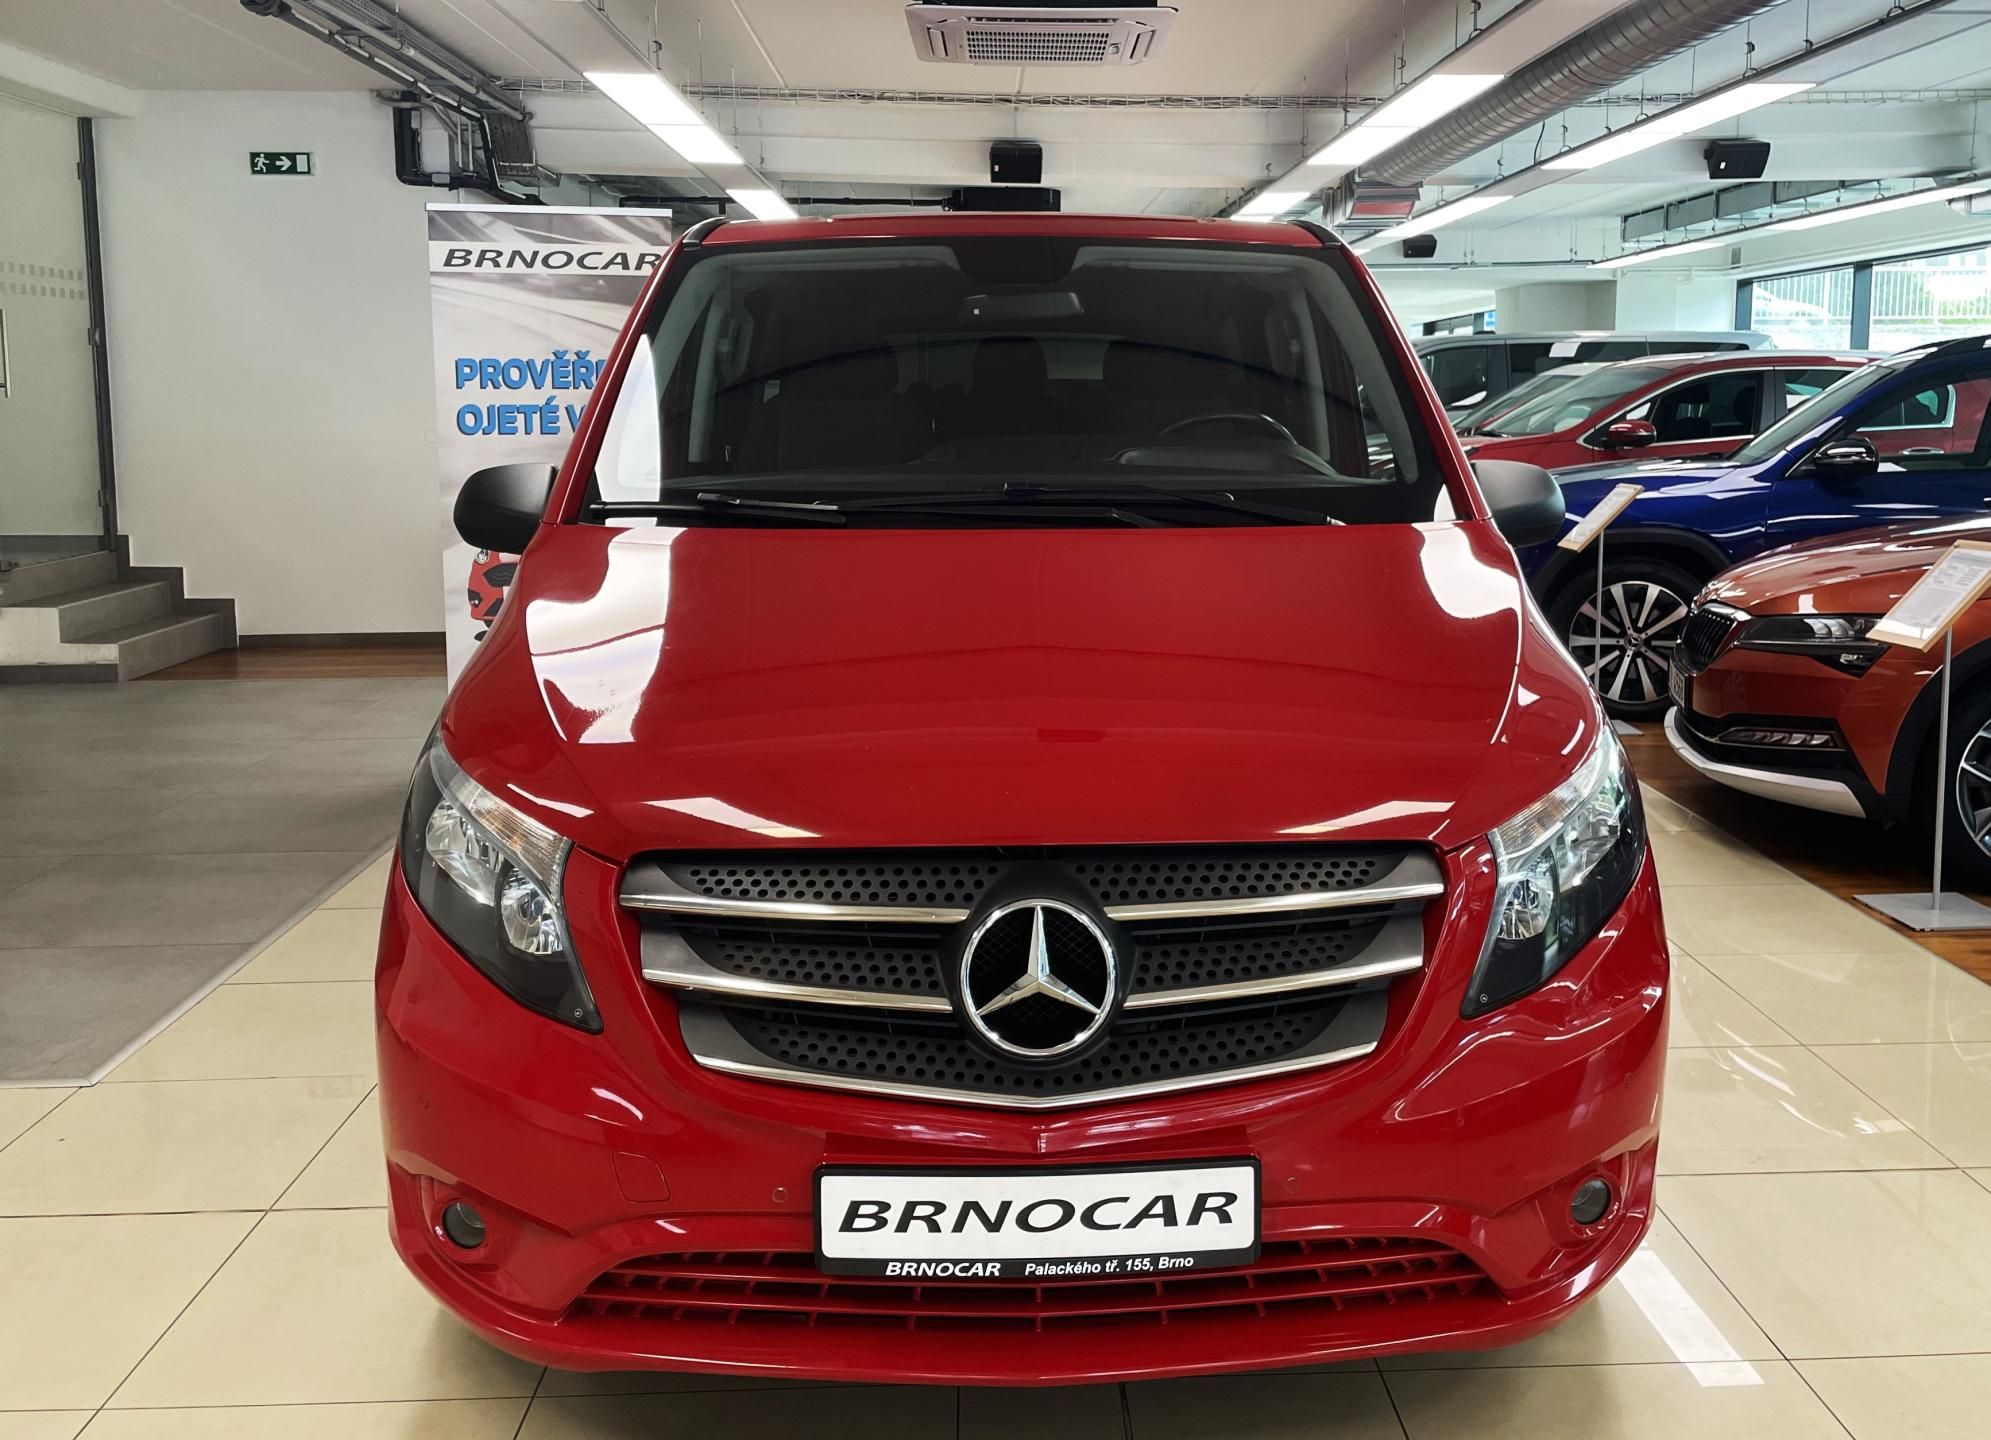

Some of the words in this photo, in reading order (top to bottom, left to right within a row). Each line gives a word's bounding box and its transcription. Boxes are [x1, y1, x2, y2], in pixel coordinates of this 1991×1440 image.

[443, 248, 661, 271] BRNOCAR
[456, 395, 561, 435] OJETÉ
[838, 1191, 1238, 1234] BRNOCAR
[885, 1261, 1001, 1277] BRNOCAR
[1024, 1261, 1101, 1276] Palackého
[1105, 1259, 1120, 1273] tř.
[1125, 1258, 1154, 1272] 155,
[1158, 1256, 1194, 1269] Brno
